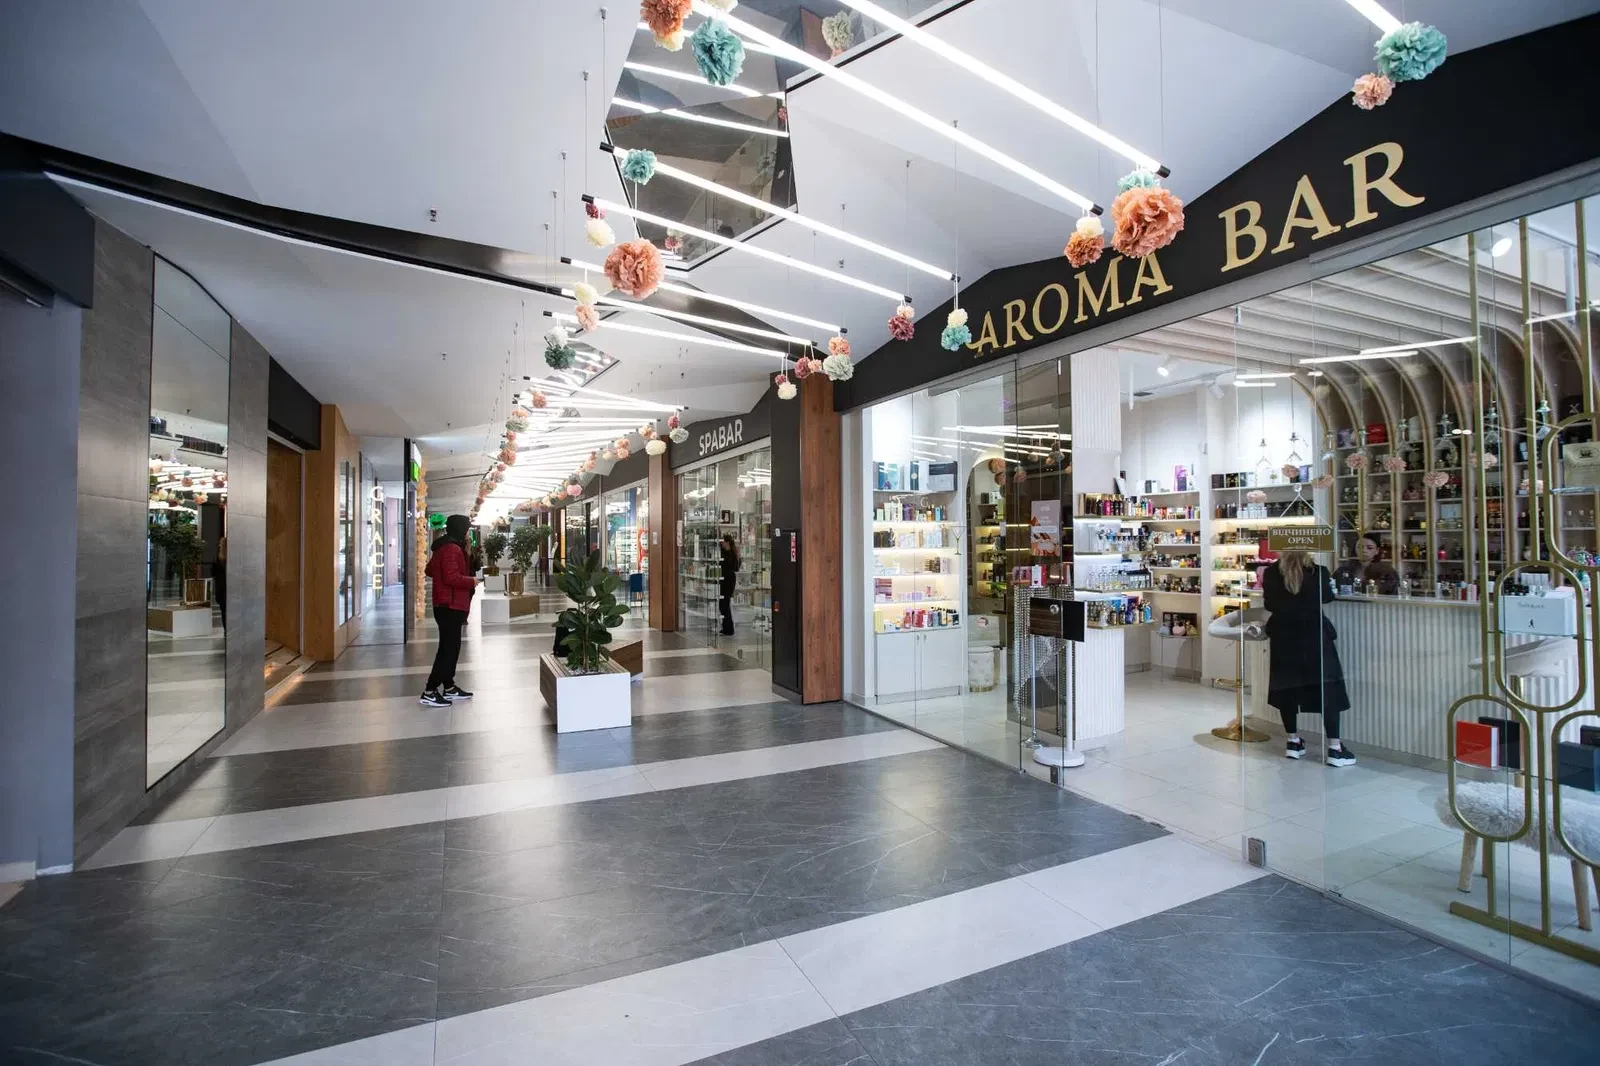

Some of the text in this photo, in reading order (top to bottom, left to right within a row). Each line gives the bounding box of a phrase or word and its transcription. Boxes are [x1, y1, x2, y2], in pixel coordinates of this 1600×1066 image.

[966, 142, 1425, 354] AROMA BAR
[699, 418, 743, 456] SPABAR
[370, 486, 384, 590] GRACE
[1287, 536, 1314, 544] OPEN
